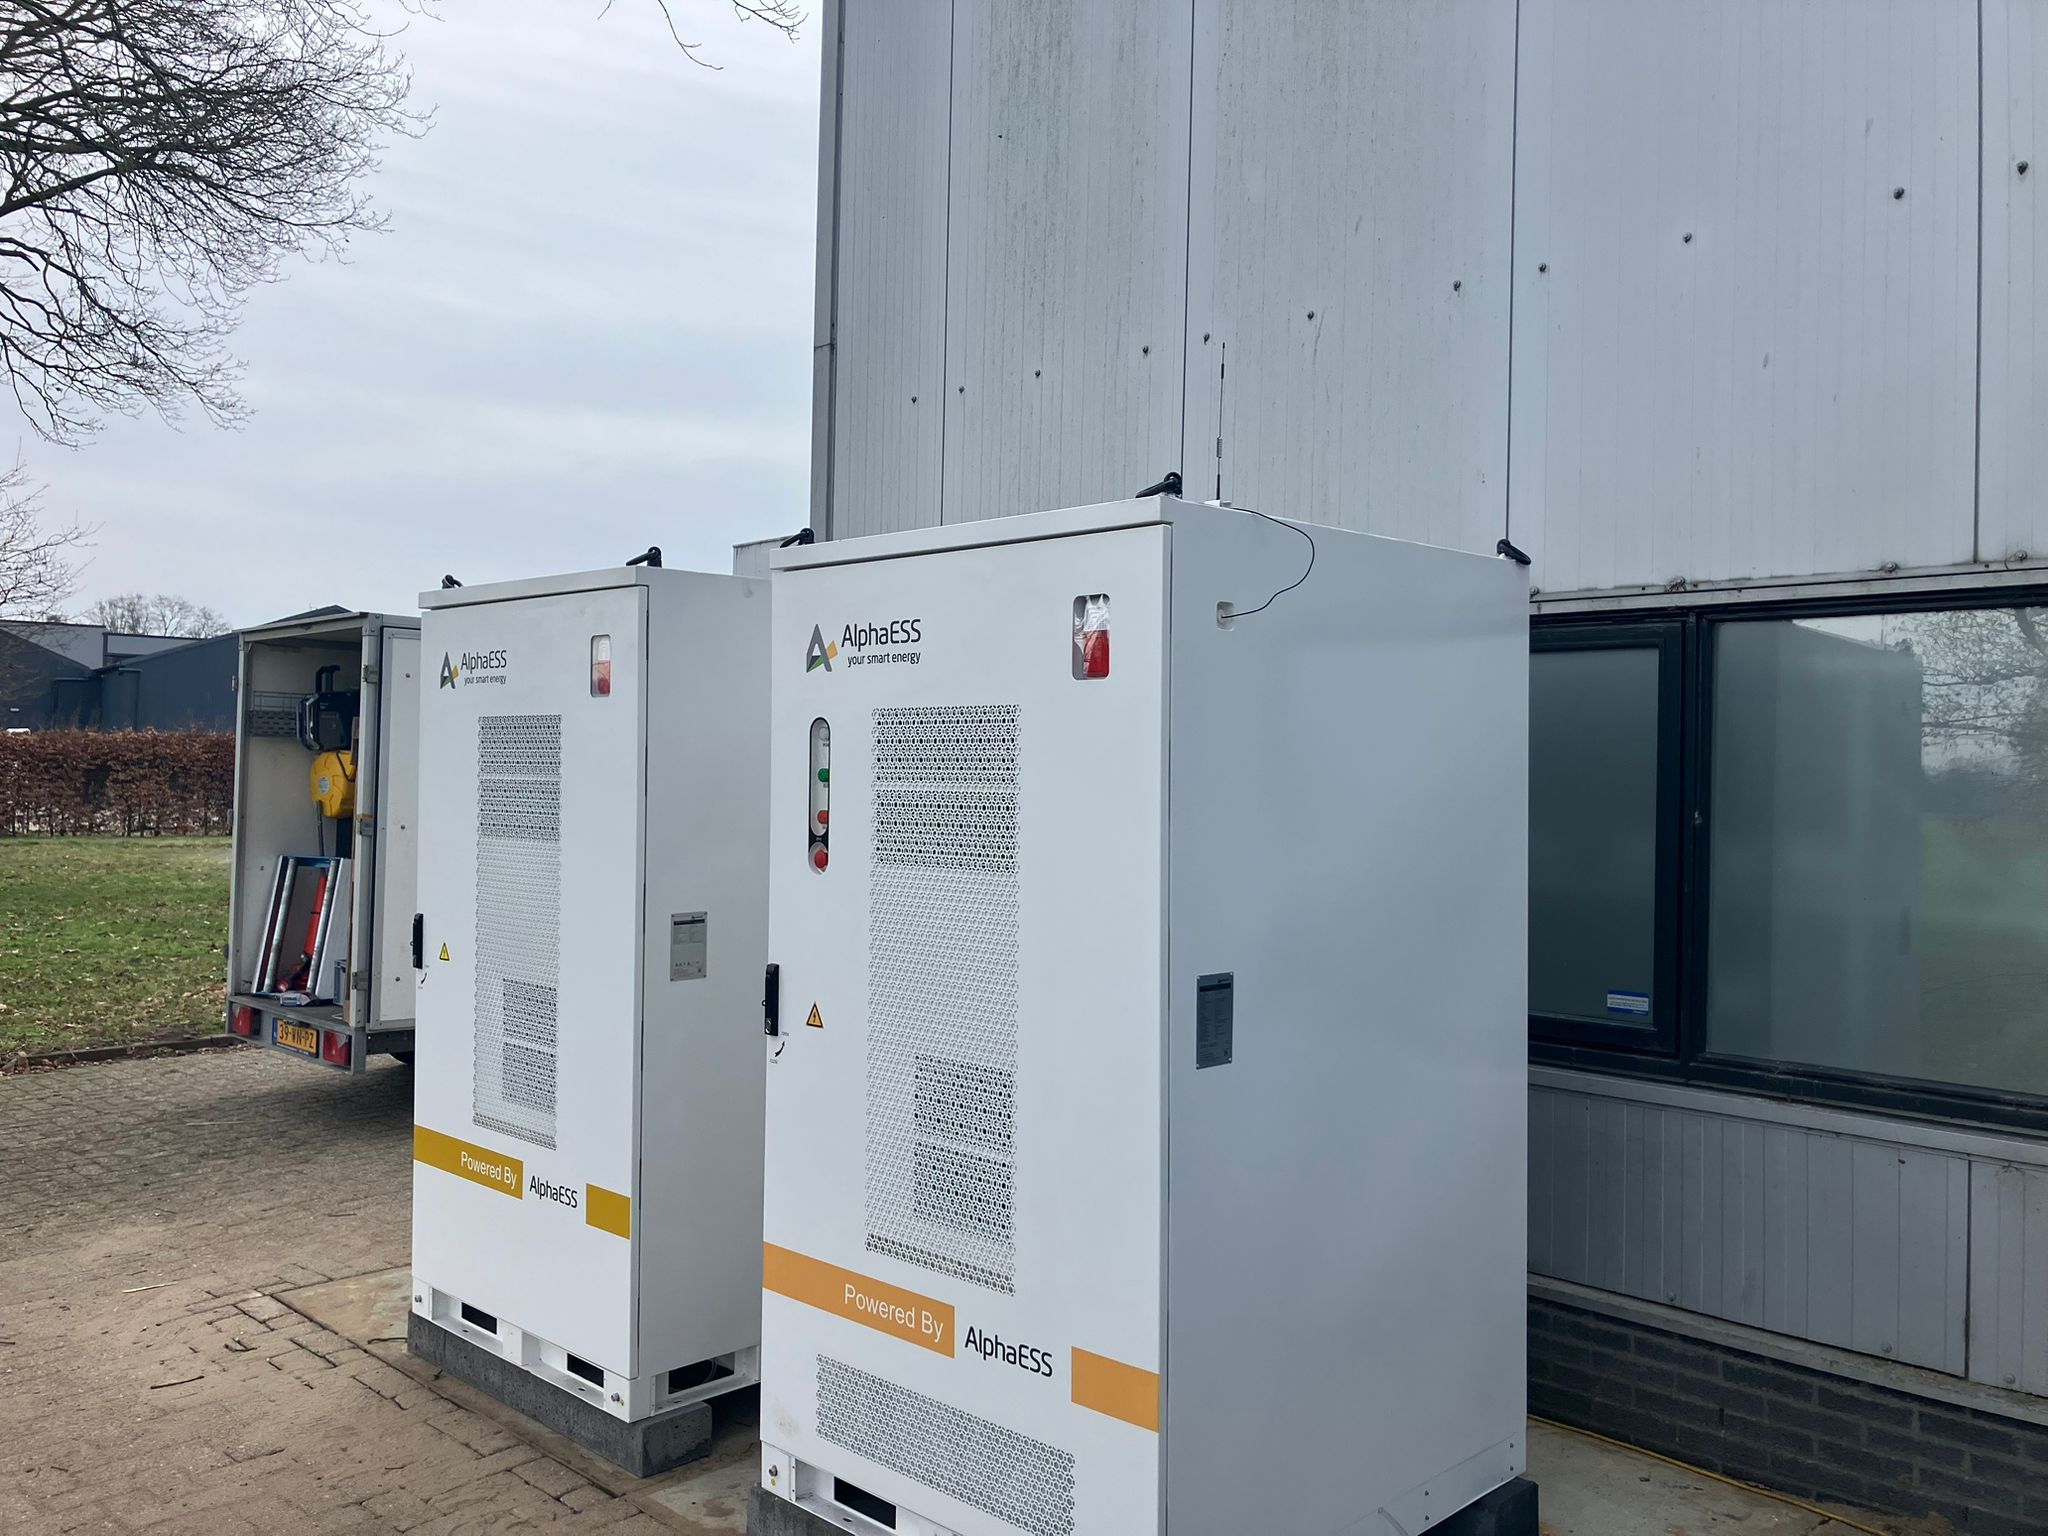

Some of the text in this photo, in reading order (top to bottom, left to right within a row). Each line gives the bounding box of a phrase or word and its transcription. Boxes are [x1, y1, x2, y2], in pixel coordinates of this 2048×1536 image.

[841, 618, 922, 652] AlphaESS
[460, 650, 507, 674] AlphaESS
[847, 651, 921, 668] your smart energy
[464, 674, 506, 686] your smart energy
[460, 1151, 517, 1190] Powered By
[529, 1175, 578, 1209] AlphaESS
[844, 1284, 944, 1343] Powered By
[964, 1325, 1053, 1378] AlphaESS
